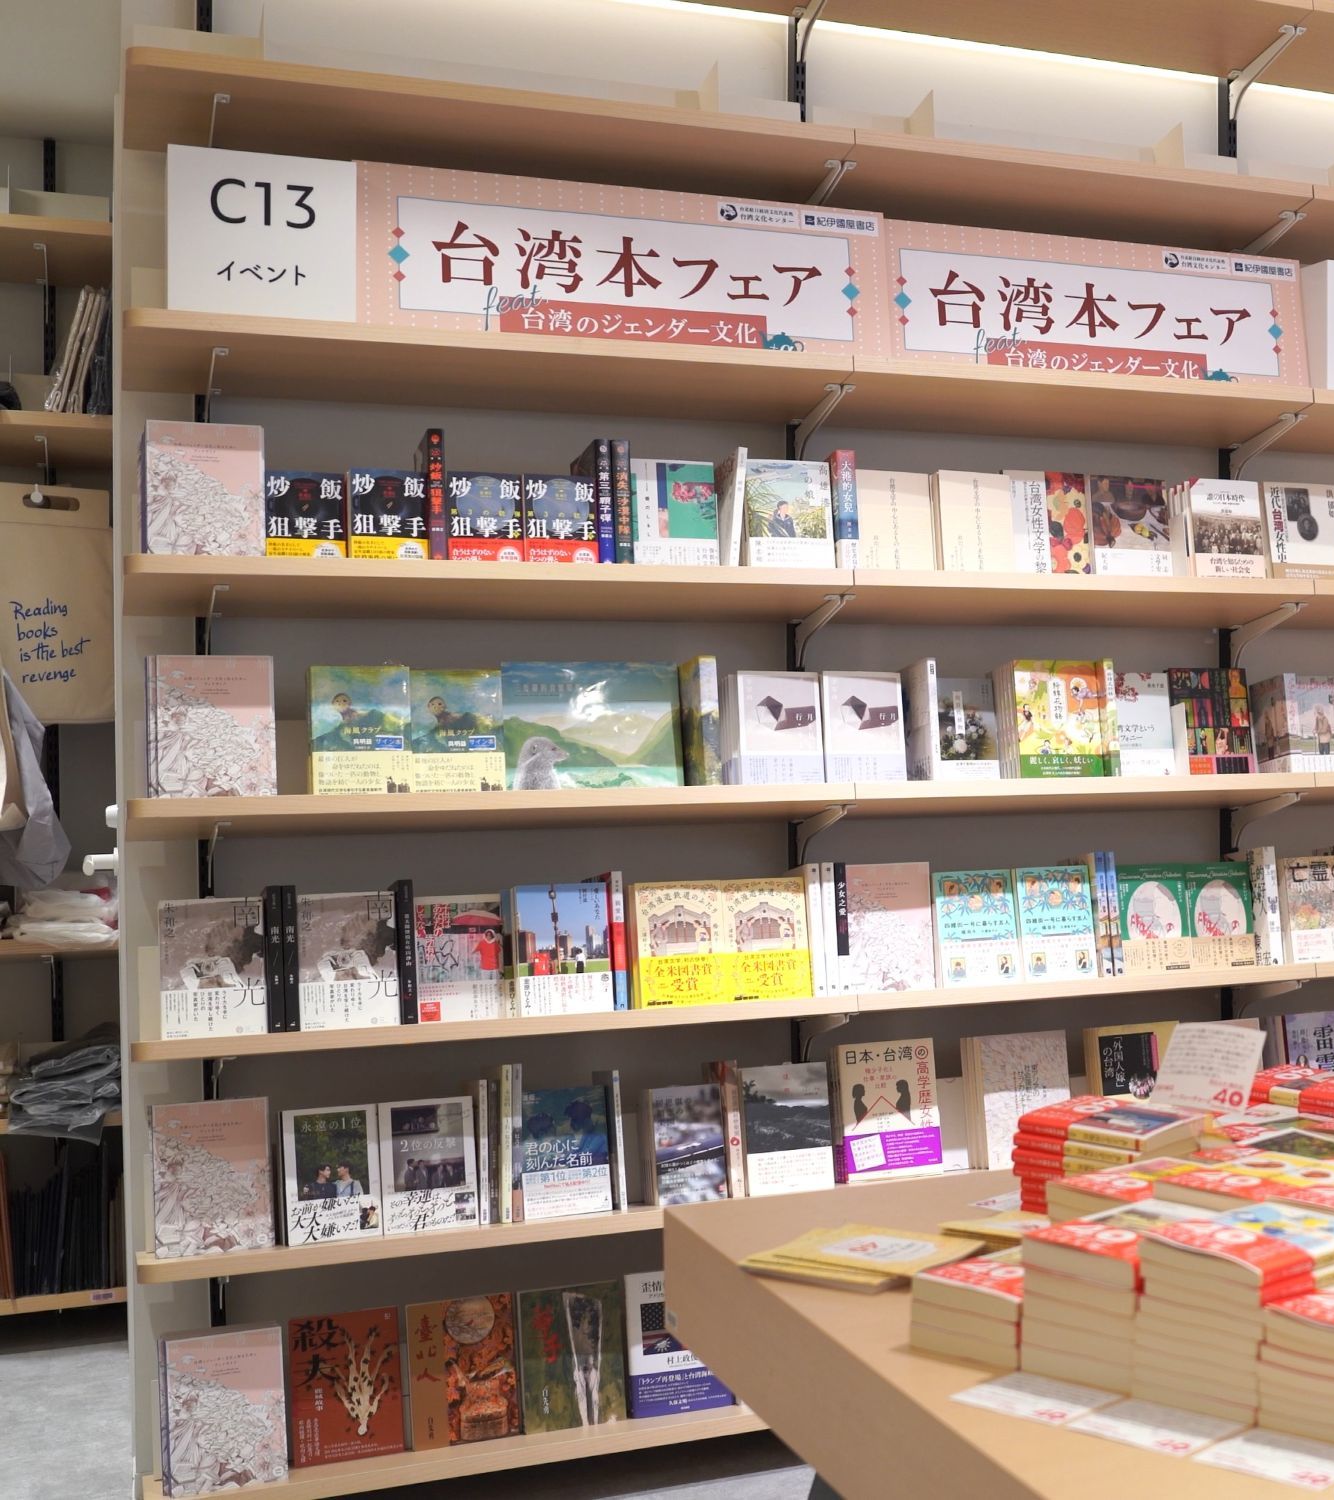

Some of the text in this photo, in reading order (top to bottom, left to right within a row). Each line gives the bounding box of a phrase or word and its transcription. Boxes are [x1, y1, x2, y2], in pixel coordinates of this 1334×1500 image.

[209, 177, 317, 230] C13
[740, 214, 794, 224] 台湾文化センター
[816, 216, 875, 231] 紀伊國屋書店
[216, 261, 307, 286] イベント
[431, 220, 822, 307] 台湾本フェア
[1244, 263, 1293, 277] 紀伊國屋書店
[929, 270, 1251, 346] 台湾本フェア
[520, 305, 758, 346] 台湾のジェンダー文化
[1006, 347, 1200, 380] 台湾のジェンダー文化
[267, 476, 343, 500] 炒飯
[352, 474, 426, 499] 炒飯
[449, 476, 521, 500] 炒飯
[526, 479, 595, 502] 炒飯
[268, 516, 343, 540] 狙撃手
[353, 513, 426, 537] 狙撃手
[450, 516, 522, 539] 狙撃手
[527, 518, 597, 540] 狙撃手
[1270, 486, 1288, 563] 近代台湾女性史
[9, 598, 68, 621] Reading
[17, 621, 58, 641] books
[20, 637, 91, 662] is the best
[22, 667, 77, 684] revenge
[837, 881, 848, 916] 少女之愛
[163, 902, 177, 938] 朱和之
[300, 897, 313, 932] 朱和之
[270, 925, 281, 944] 南光
[285, 925, 296, 944] 南光
[655, 963, 713, 977] 全米図書賞
[740, 959, 797, 973] 全米図書賞
[369, 970, 400, 1000] 光
[670, 977, 699, 991] 受賞
[758, 972, 783, 986] 受賞
[233, 977, 266, 1009] 光
[846, 1046, 913, 1065] 日本・台湾
[1102, 1047, 1117, 1080] の台湾
[1112, 1034, 1126, 1090] 「外国人嫁」
[875, 1082, 887, 1090] 比較
[916, 1061, 934, 1128] 高学歴女性
[1213, 1088, 1243, 1106] 40
[301, 1116, 362, 1132] 永遠の1位
[400, 1139, 457, 1152] 2位の反撃
[525, 1139, 580, 1155] 君の心に
[526, 1152, 593, 1171] 刻んだ名前
[583, 1167, 607, 1178] 第2位
[540, 1172, 566, 1182] 第1位
[293, 1317, 342, 1388] 殺夫
[415, 1314, 441, 1383] 臺北人
[542, 1386, 550, 1415] 白先勇
